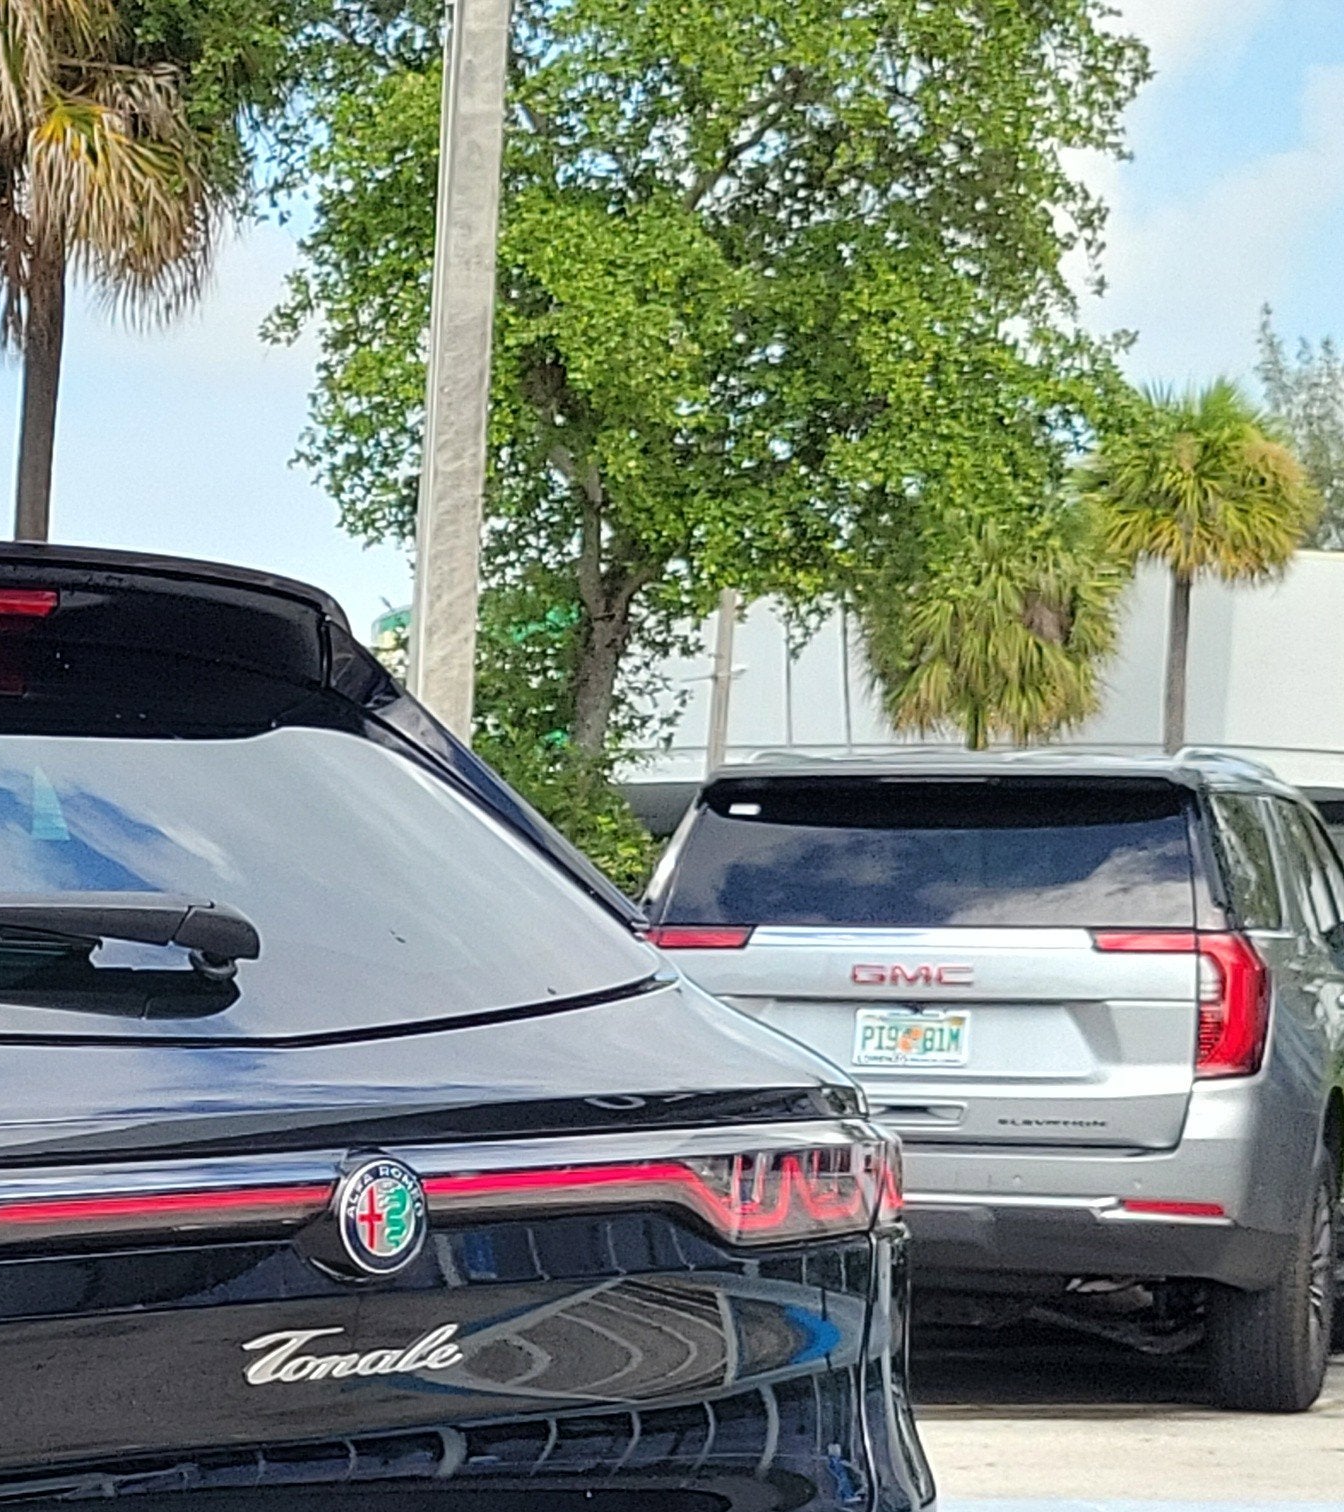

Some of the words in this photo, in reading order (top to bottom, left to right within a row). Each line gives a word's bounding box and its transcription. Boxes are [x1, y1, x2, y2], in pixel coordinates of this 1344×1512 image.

[852, 964, 974, 986] GMC
[347, 1173, 374, 1218] ALFA
[379, 1166, 422, 1217] ROMEO
[241, 1324, 463, 1385] Tonale
